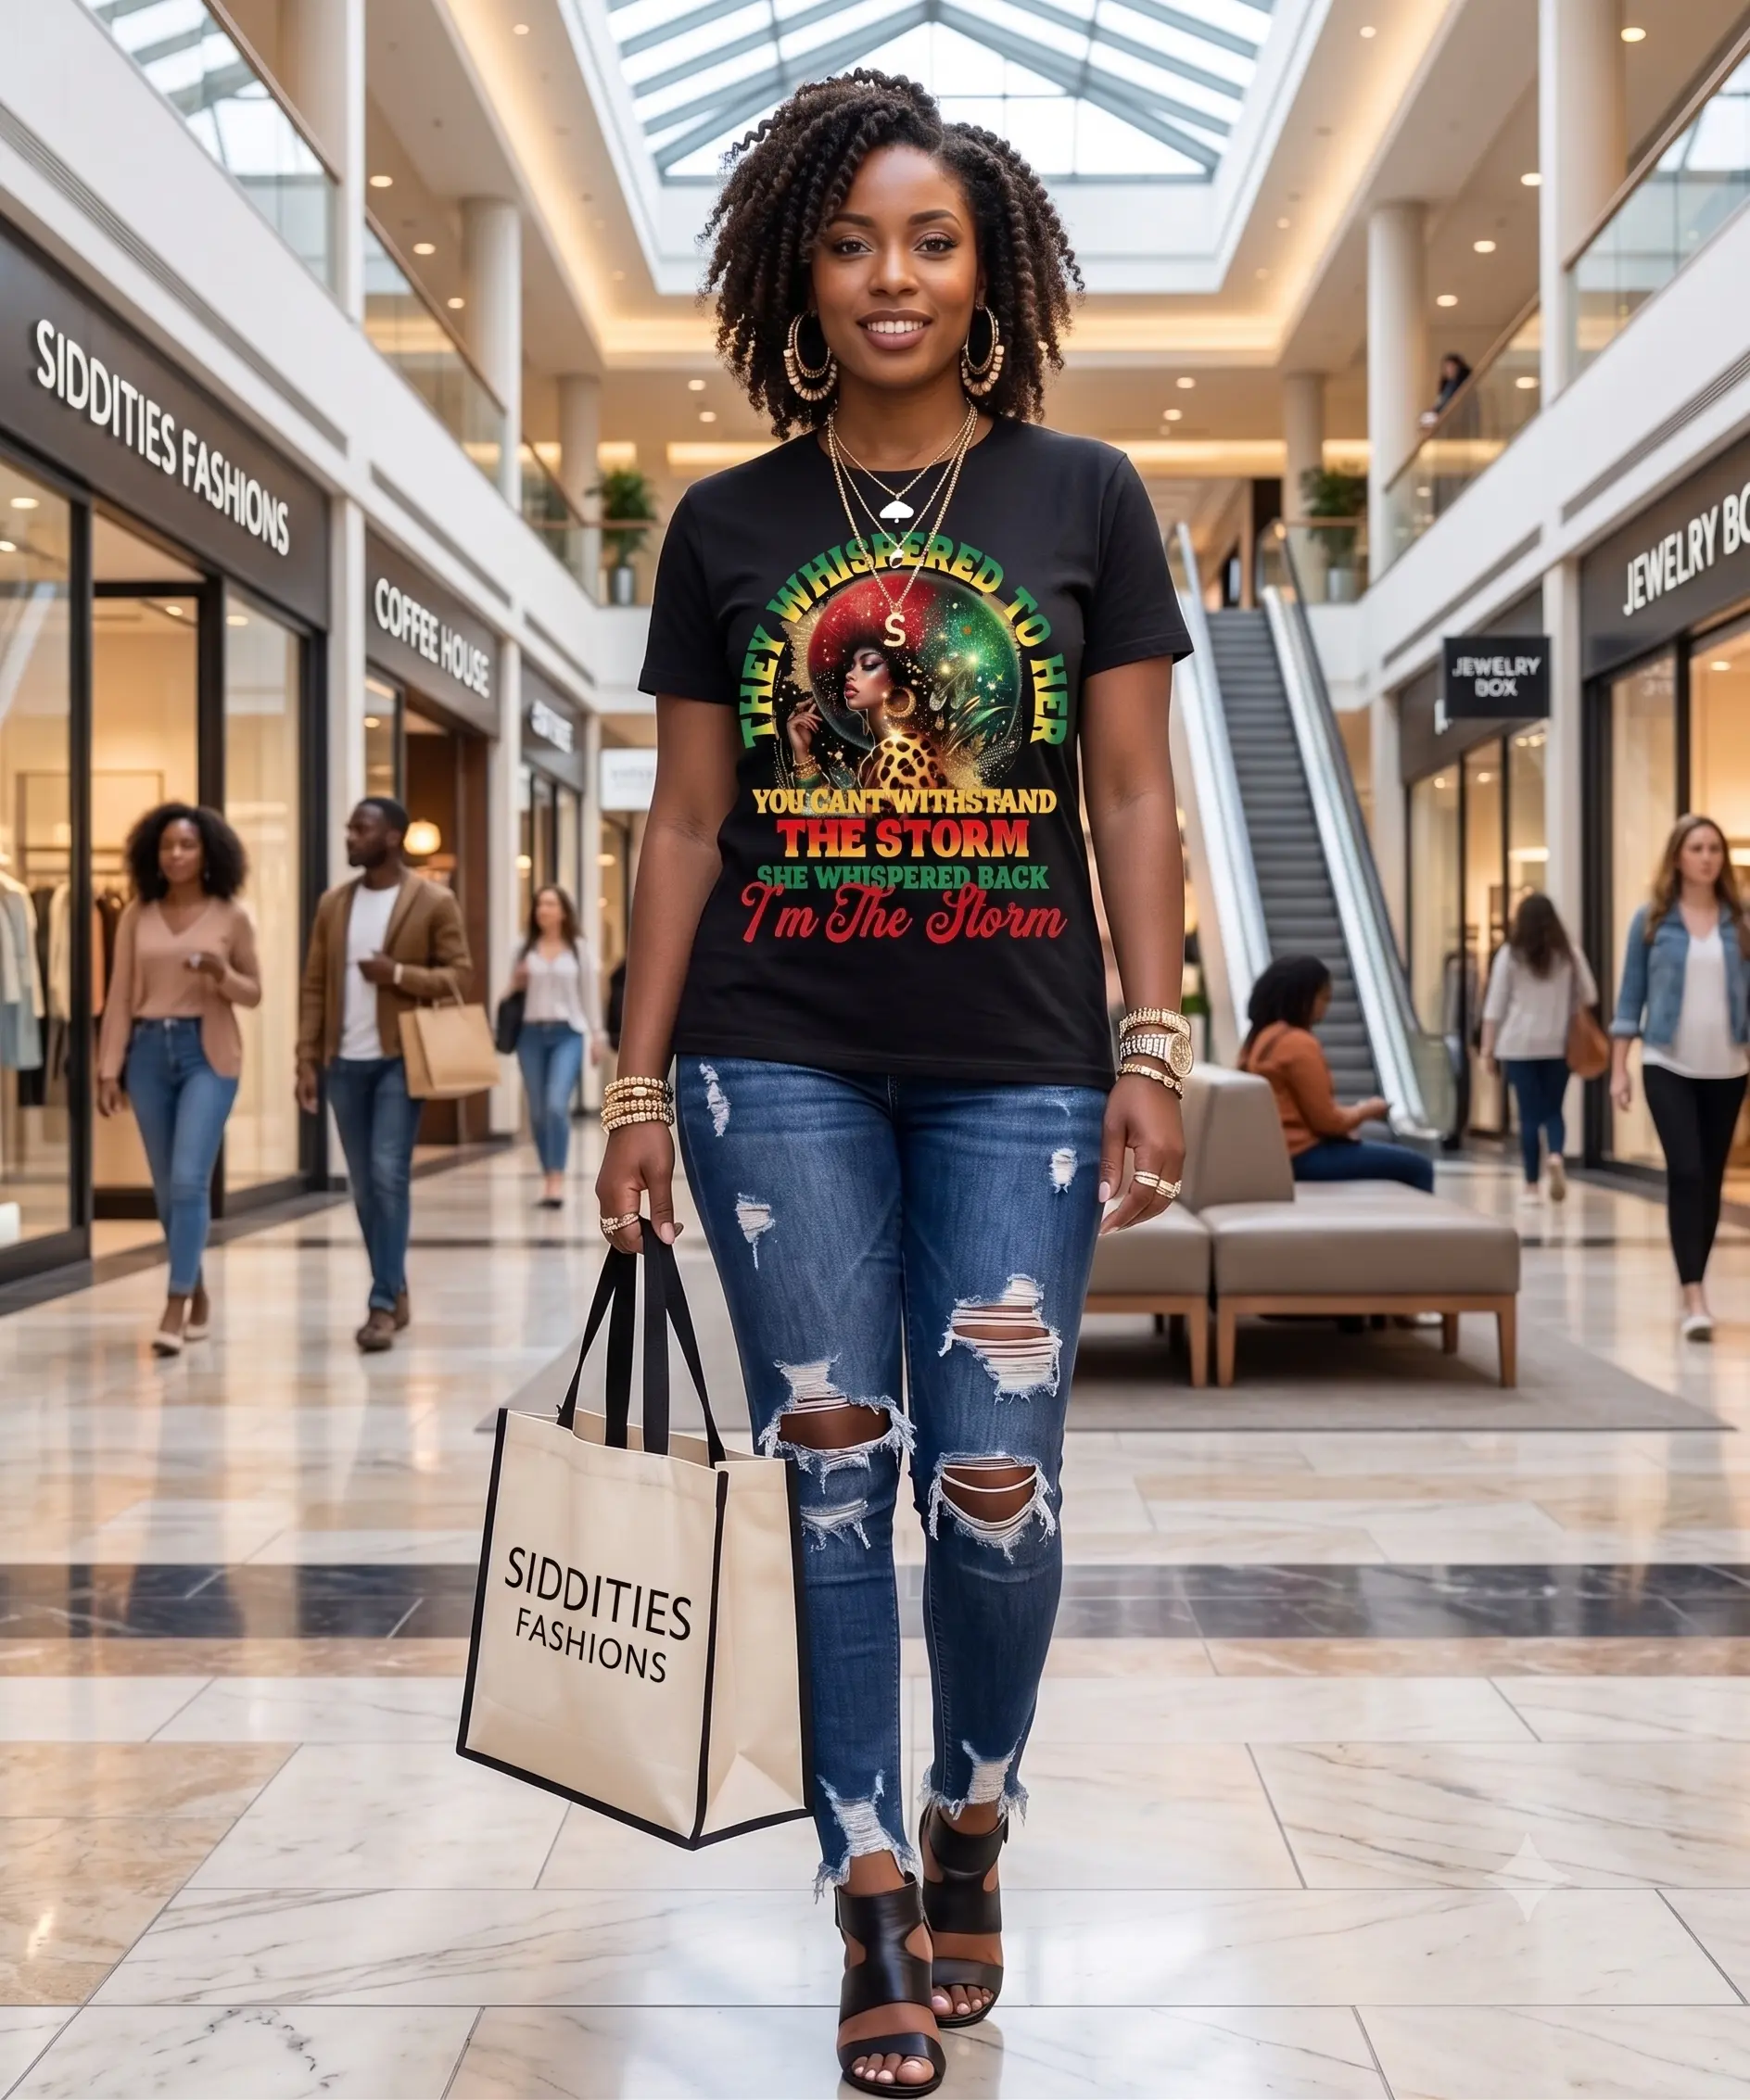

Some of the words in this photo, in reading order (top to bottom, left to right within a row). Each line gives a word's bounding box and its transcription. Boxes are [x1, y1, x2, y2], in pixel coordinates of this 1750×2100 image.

[35, 319, 177, 475] SIDDITIES
[183, 428, 290, 556] FASHIONS
[1623, 505, 1718, 616] JEWELRY
[374, 576, 438, 664] COFFEE
[441, 626, 490, 699] HOUSE
[740, 624, 785, 749] THEY
[766, 531, 1005, 624] WHISPERED
[1003, 586, 1052, 647] TO
[1030, 652, 1069, 745] HER
[883, 612, 907, 648] S
[1452, 656, 1541, 677] JEWELRY
[1475, 677, 1518, 697] BOX
[752, 789, 807, 814] YOU
[811, 789, 882, 814] CANT
[889, 789, 1058, 814] WITHSTAND
[777, 819, 867, 857] THE
[876, 819, 1030, 857] STORM
[756, 866, 808, 890] SHE
[814, 866, 970, 890] WHISPERED
[978, 866, 1049, 890] BACK
[742, 881, 819, 943] I'm
[825, 883, 913, 943] The
[925, 883, 1068, 944] Storm
[504, 1546, 691, 1640] SIDDITIES
[515, 1608, 666, 1683] FASHIONS
